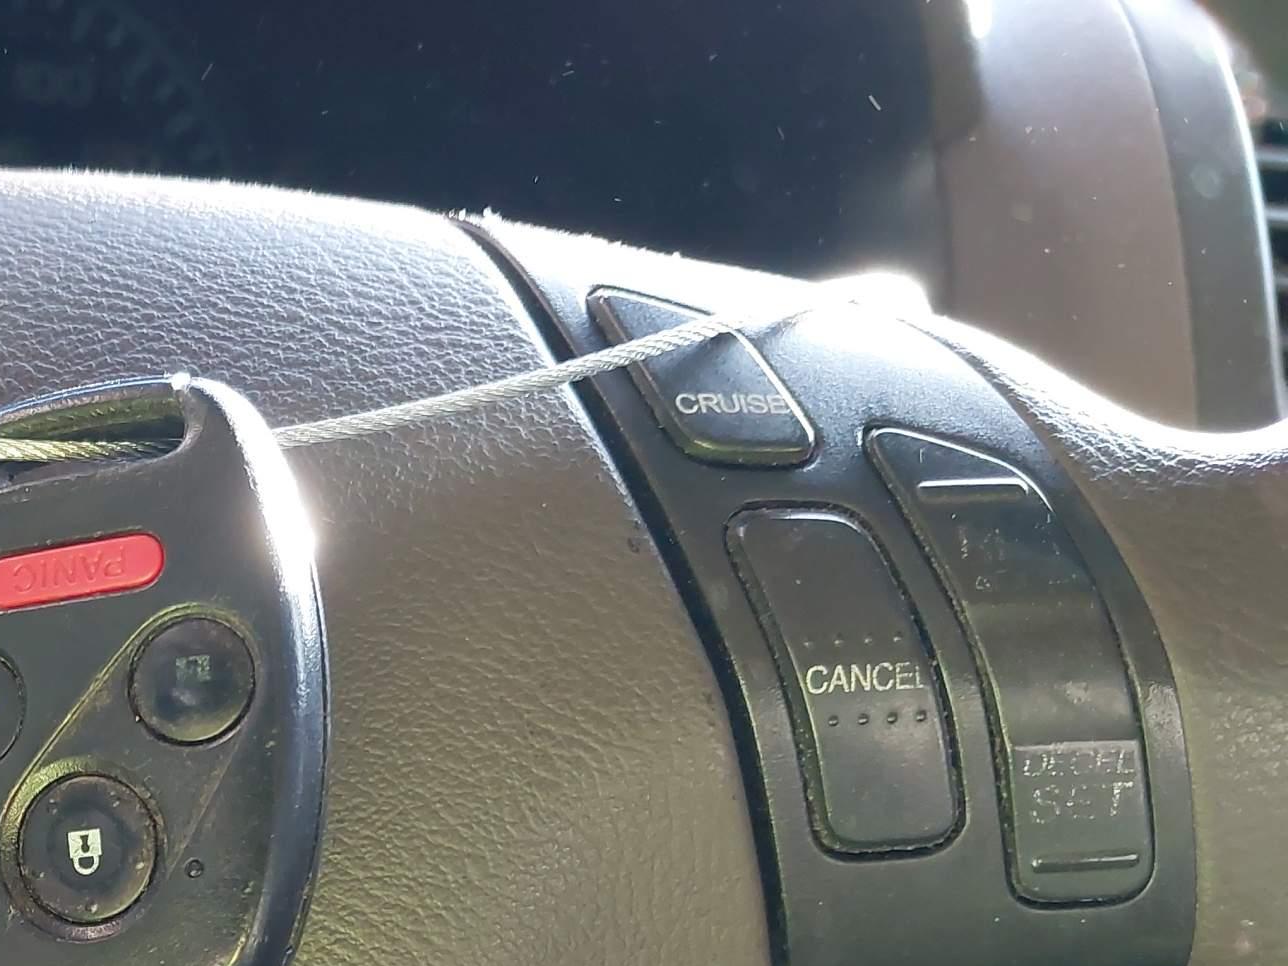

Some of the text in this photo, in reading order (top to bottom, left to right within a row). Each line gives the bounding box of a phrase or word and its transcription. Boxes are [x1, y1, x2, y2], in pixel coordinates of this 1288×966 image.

[674, 392, 792, 415] CRUISE
[12, 543, 128, 593] PANIC
[805, 661, 925, 695] CANCEL
